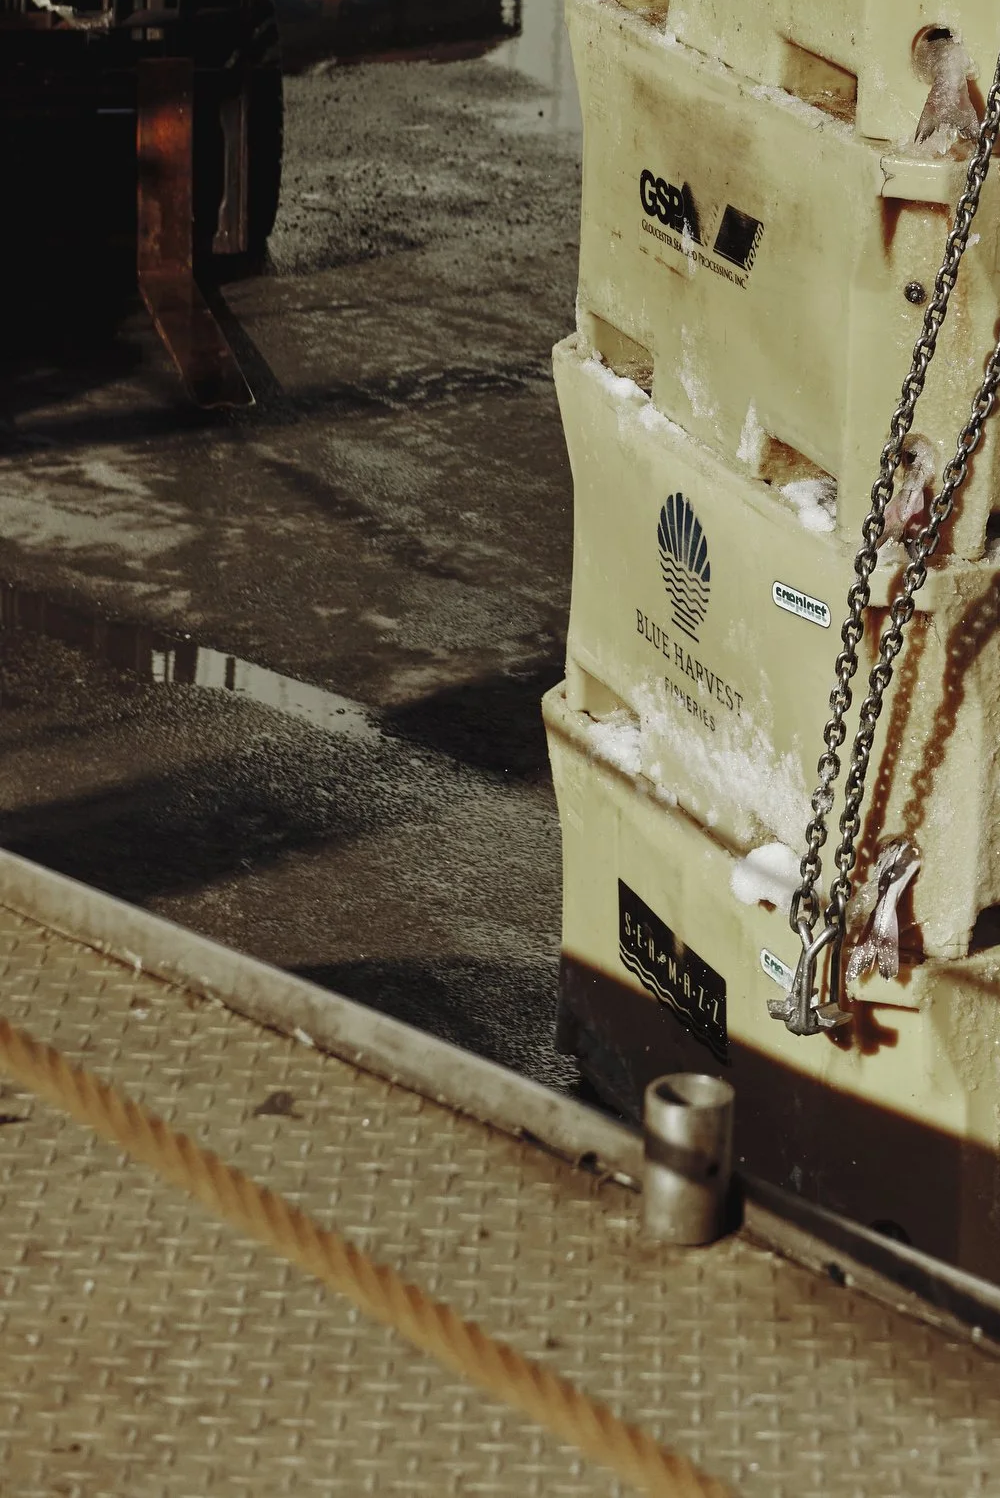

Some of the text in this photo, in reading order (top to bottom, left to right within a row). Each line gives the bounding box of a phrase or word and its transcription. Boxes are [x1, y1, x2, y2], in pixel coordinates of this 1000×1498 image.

[636, 608, 744, 718] BLUE HARVEST
[664, 676, 716, 733] FISHERIES
